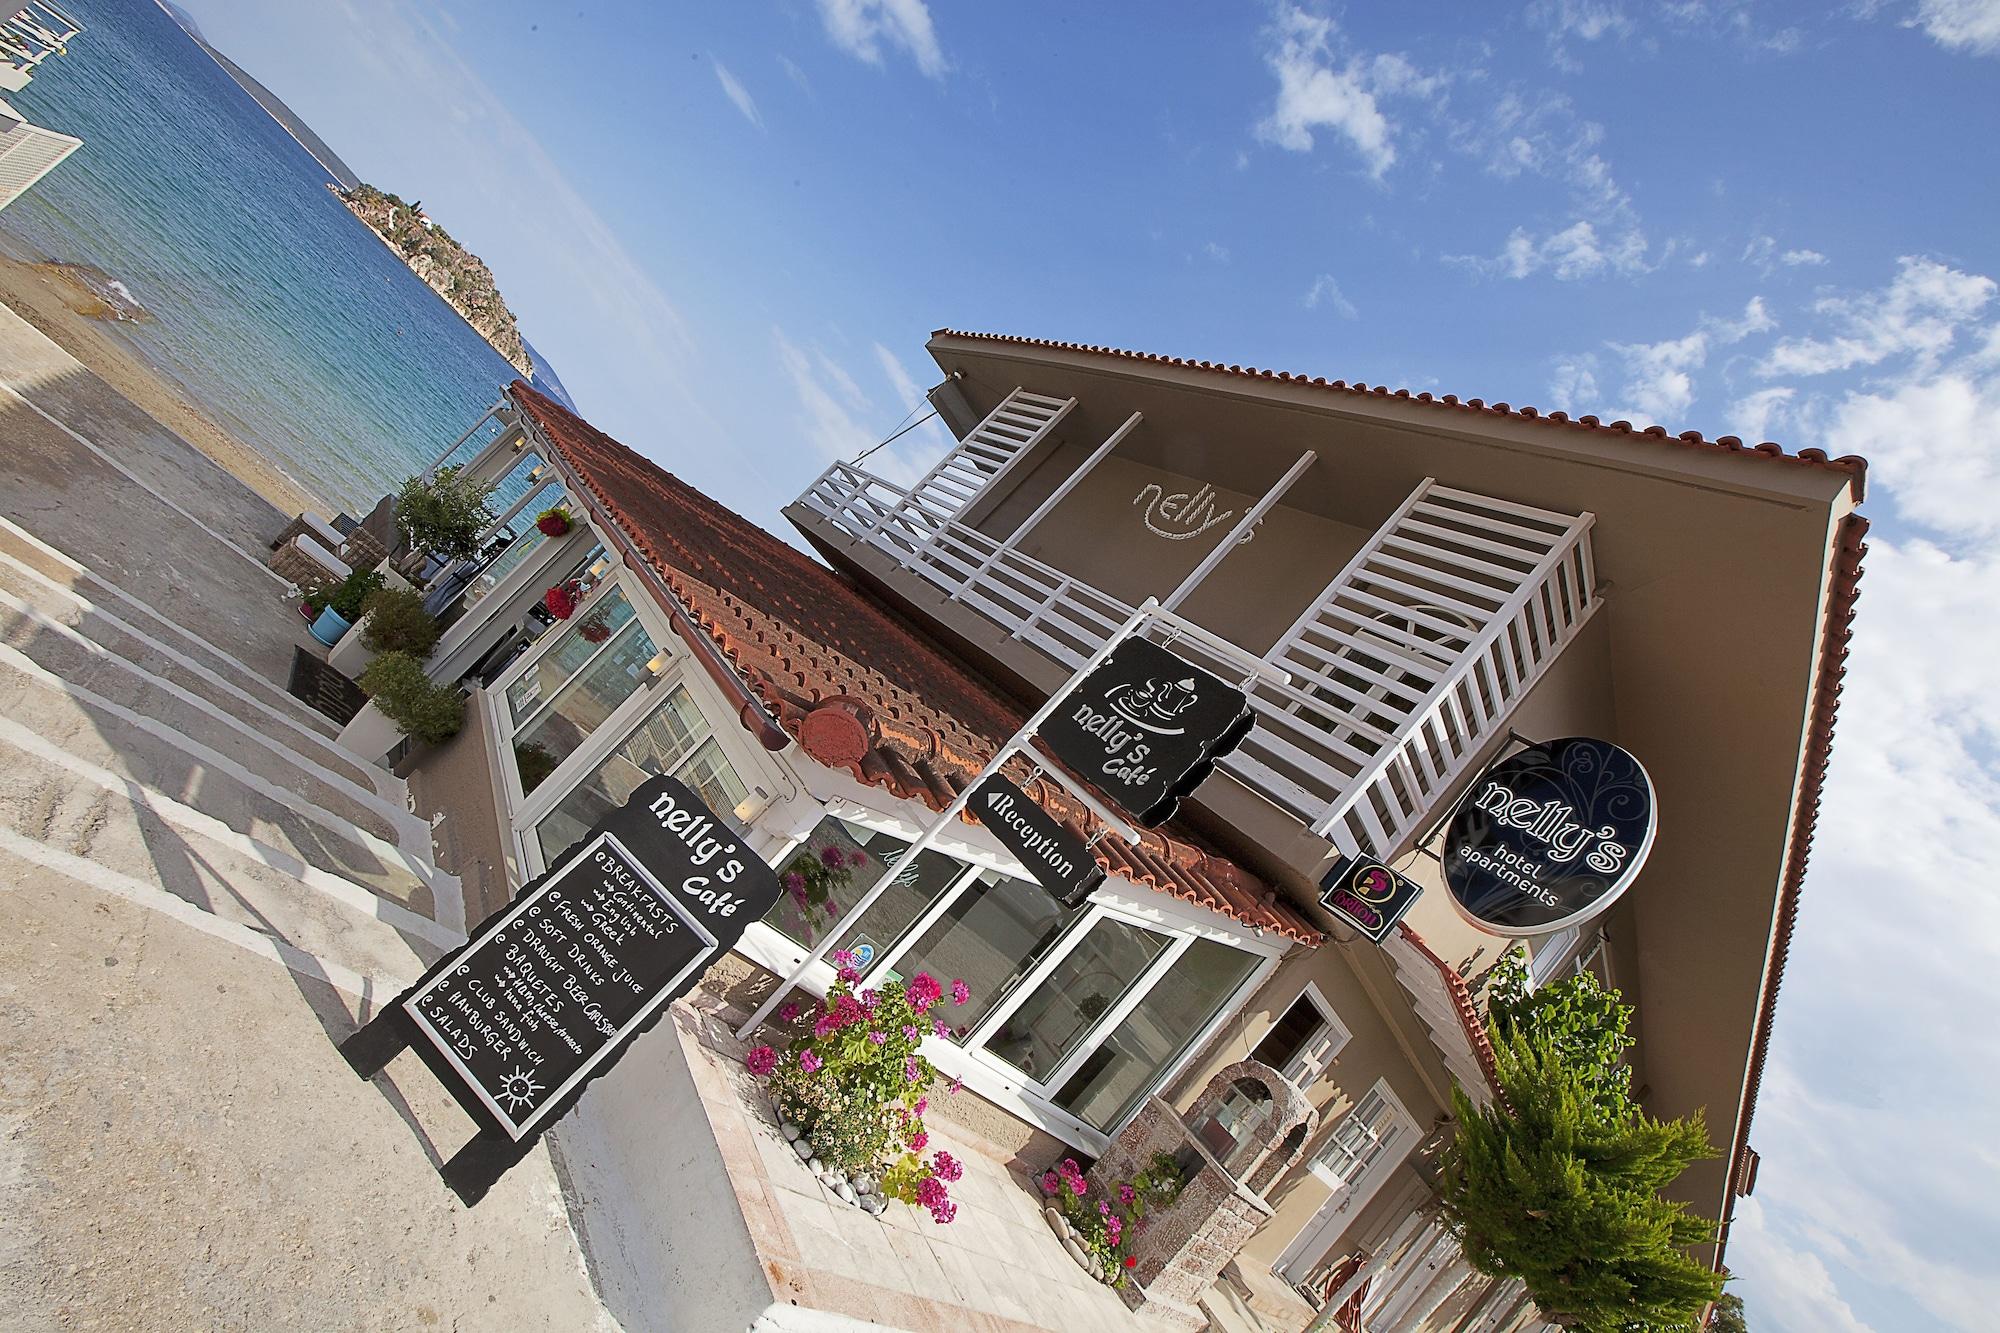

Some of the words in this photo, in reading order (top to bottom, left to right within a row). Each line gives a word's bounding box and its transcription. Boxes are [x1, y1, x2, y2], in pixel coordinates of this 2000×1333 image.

[1072, 703, 1151, 765] nelly's
[1102, 758, 1157, 786] Café
[648, 791, 745, 883] nelly's
[994, 795, 1075, 879] Reception
[1475, 781, 1627, 874] nelly's
[1494, 843, 1542, 880] hotel
[601, 857, 679, 934] BREAKFASTS
[682, 876, 746, 917] Café
[1460, 844, 1559, 908] apartments
[554, 900, 585, 931] FRESH
[584, 933, 619, 969] ORANGE
[612, 968, 644, 994] JUICE
[602, 900, 637, 937] English
[613, 892, 663, 939] Continental
[505, 943, 565, 1013] BAQUETES
[523, 929, 565, 973] DRAUGHT
[562, 974, 590, 1006] BEER
[539, 918, 567, 944] SOFT
[568, 944, 605, 986] DRINKS
[430, 1006, 478, 1060] SALADS
[448, 991, 512, 1061] HAMBURGER
[468, 979, 496, 1010] CLUB
[494, 1011, 545, 1066] SANDWICH
[503, 988, 523, 1012] tuna
[519, 1010, 539, 1032] fish
